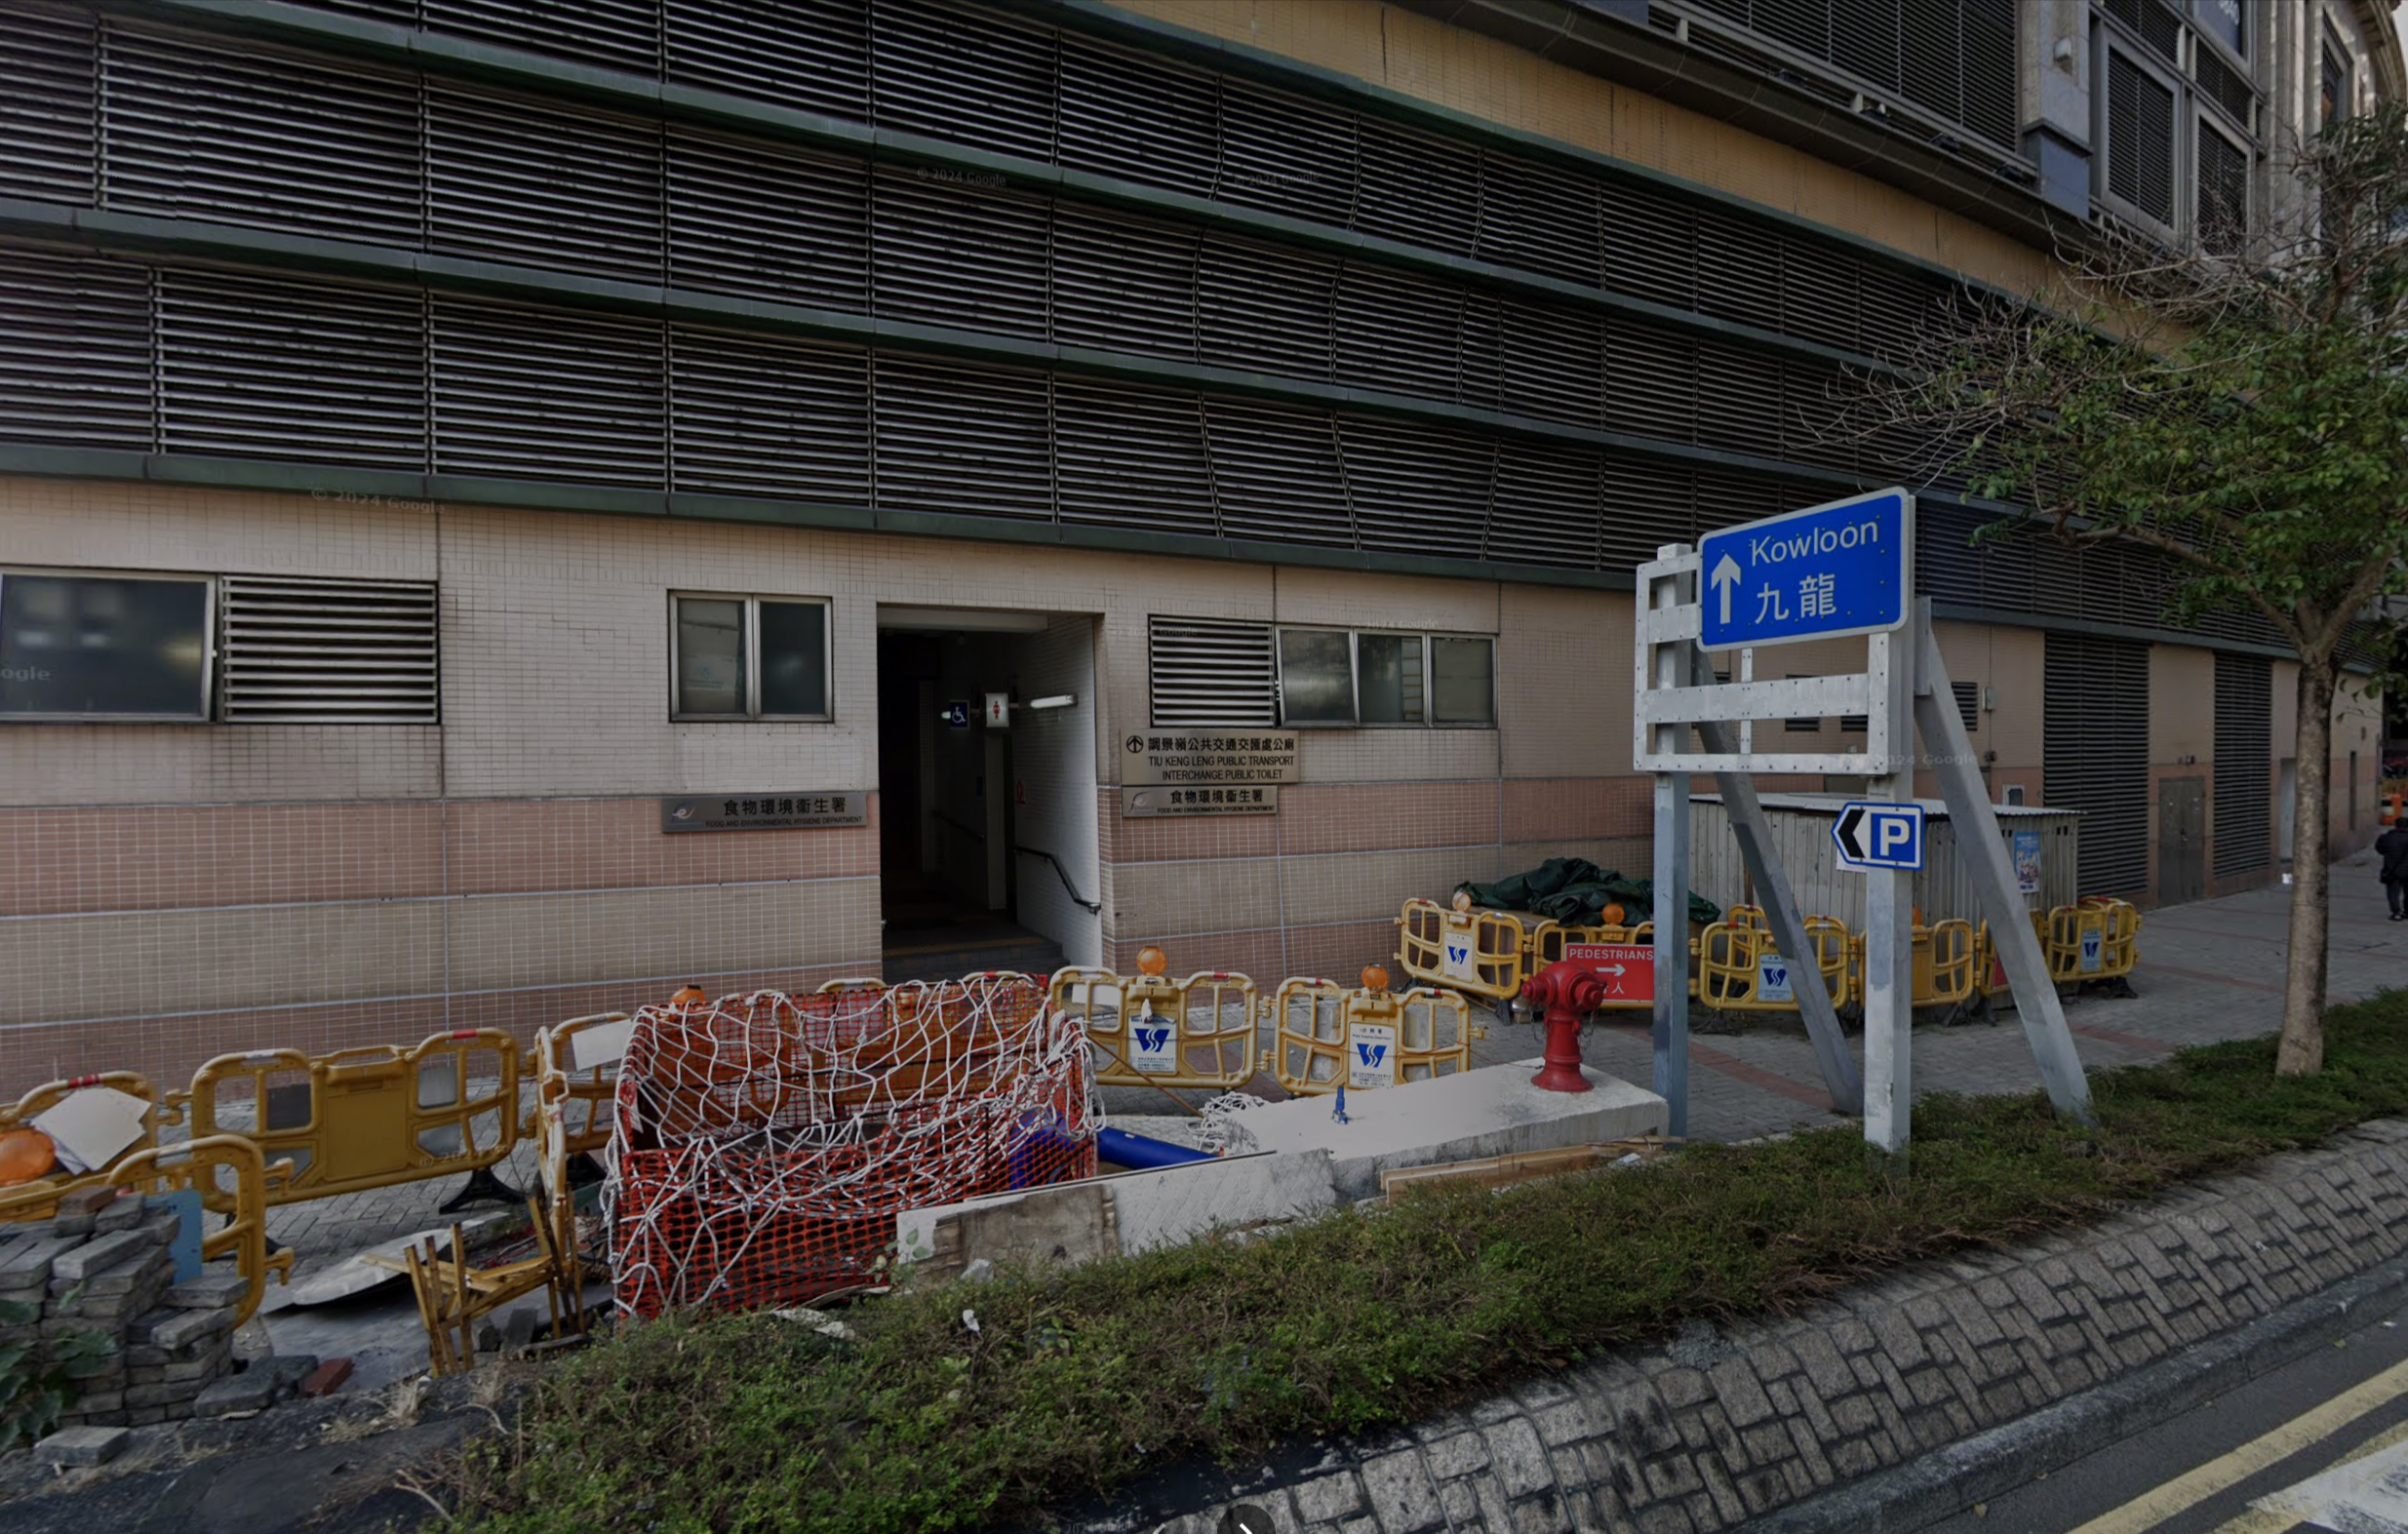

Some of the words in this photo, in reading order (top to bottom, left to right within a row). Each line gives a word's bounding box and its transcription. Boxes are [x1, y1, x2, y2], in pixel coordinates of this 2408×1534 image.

[1751, 521, 1879, 567] Kowloon
[1755, 573, 1836, 624] 九龍
[1149, 756, 1163, 767] TIU
[1165, 756, 1190, 767] KENG
[1192, 756, 1214, 767] LENG
[1217, 756, 1246, 766] PUBLIC
[1248, 756, 1294, 766] TRANSPORT
[1163, 769, 1223, 780] INTERCHANGE
[1225, 769, 1254, 780] PUBLIC
[1256, 769, 1283, 779] TOILET
[741, 818, 792, 827] ENVIRONMENTAL
[1879, 817, 1911, 856] P
[1569, 949, 1654, 961] PEDESTRIANS
